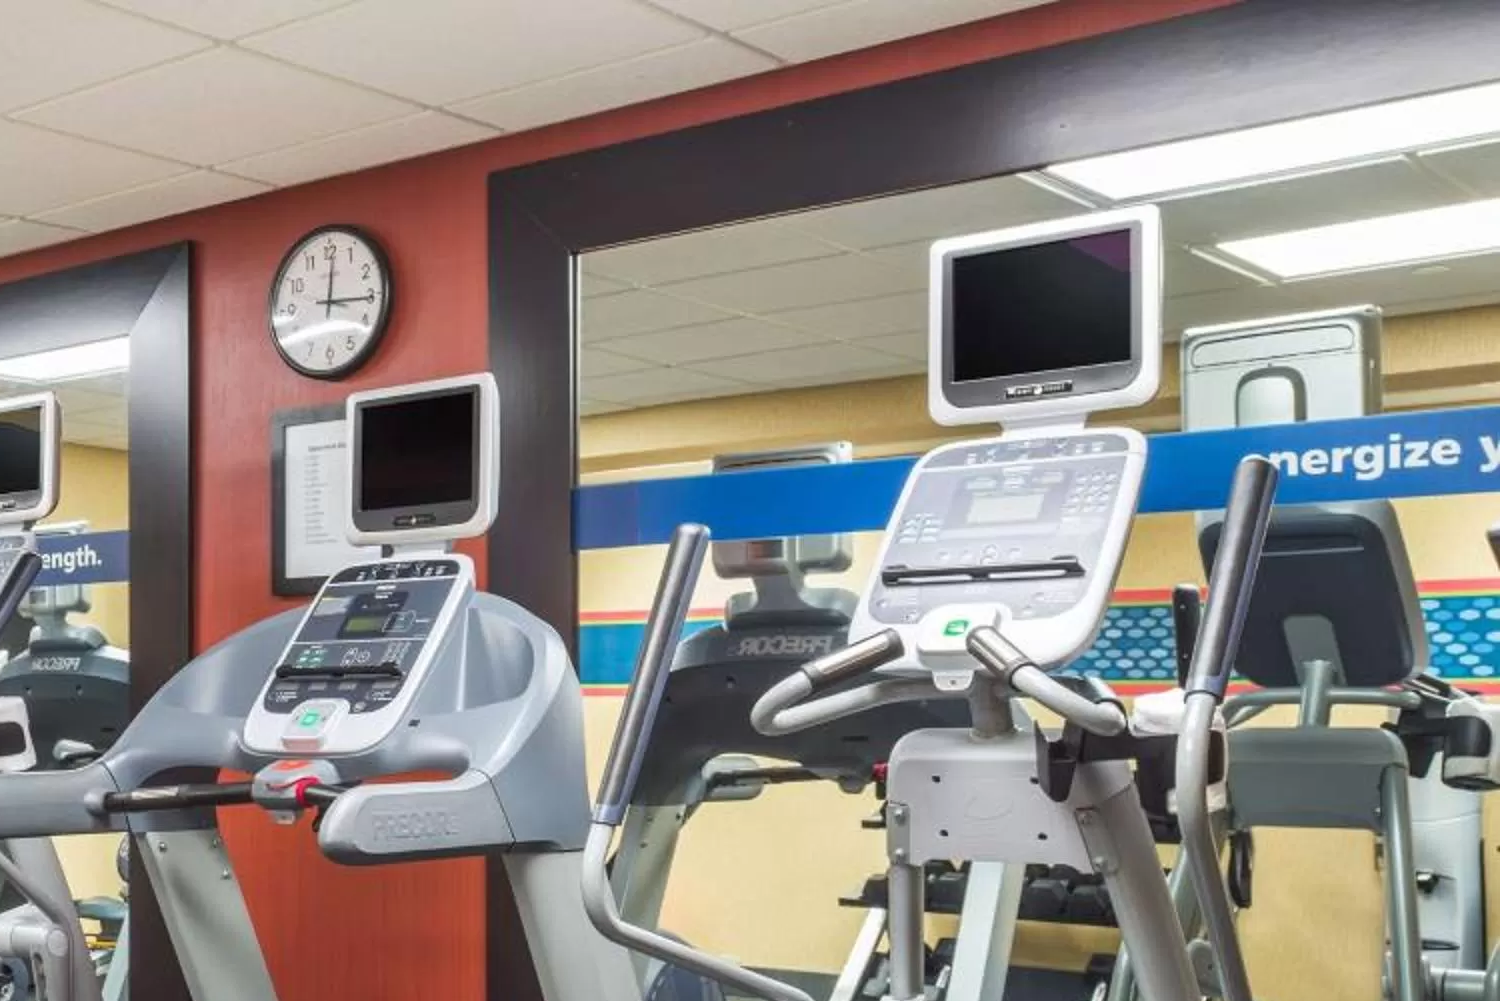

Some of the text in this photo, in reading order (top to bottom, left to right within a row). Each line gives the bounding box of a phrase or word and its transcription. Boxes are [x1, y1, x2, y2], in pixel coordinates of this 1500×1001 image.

[323, 245, 337, 261] 12
[305, 255, 315, 271] 11
[361, 263, 371, 281] 2
[290, 277, 305, 295] 10
[366, 287, 375, 305] 3
[287, 303, 297, 317] 9
[345, 335, 356, 351] 5
[325, 344, 335, 365] 6
[1243, 433, 1461, 481] nergize
[35, 545, 102, 573] ength.
